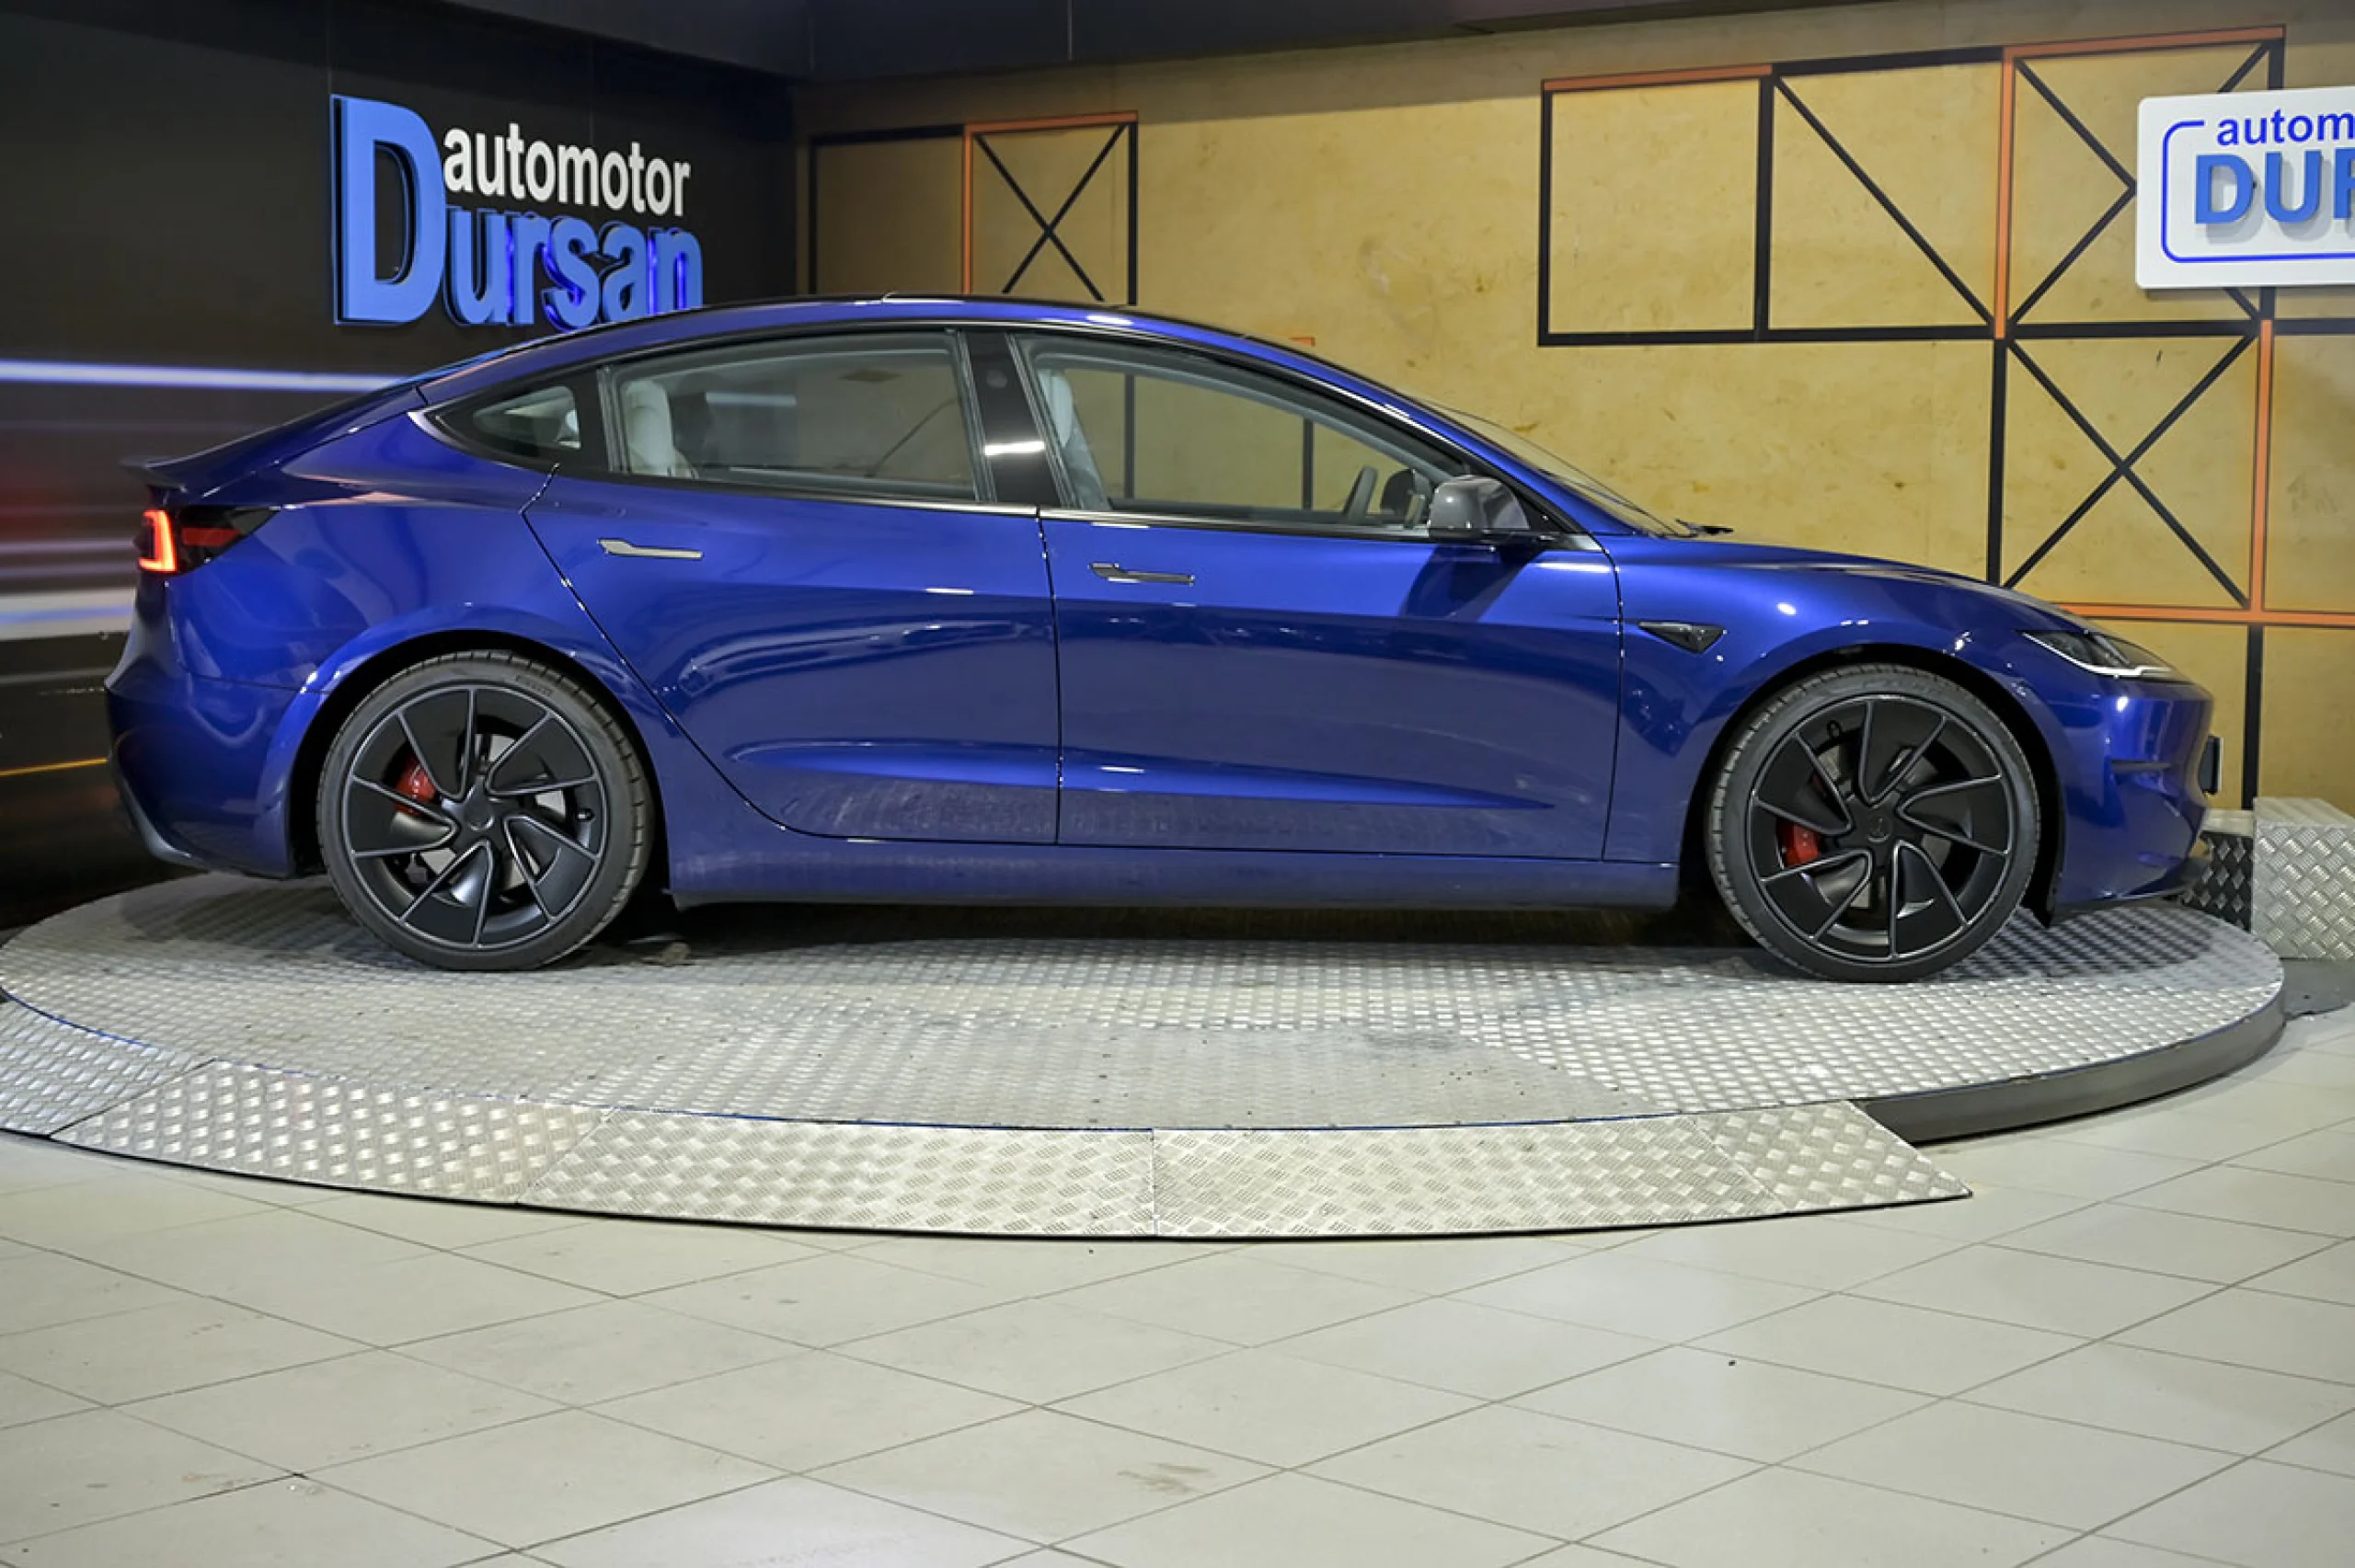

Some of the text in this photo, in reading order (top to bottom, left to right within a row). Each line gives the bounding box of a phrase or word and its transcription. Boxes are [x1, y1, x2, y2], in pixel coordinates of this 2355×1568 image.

[443, 122, 691, 216] automotor
[2217, 109, 2355, 145] autom
[330, 94, 703, 331] Dursan
